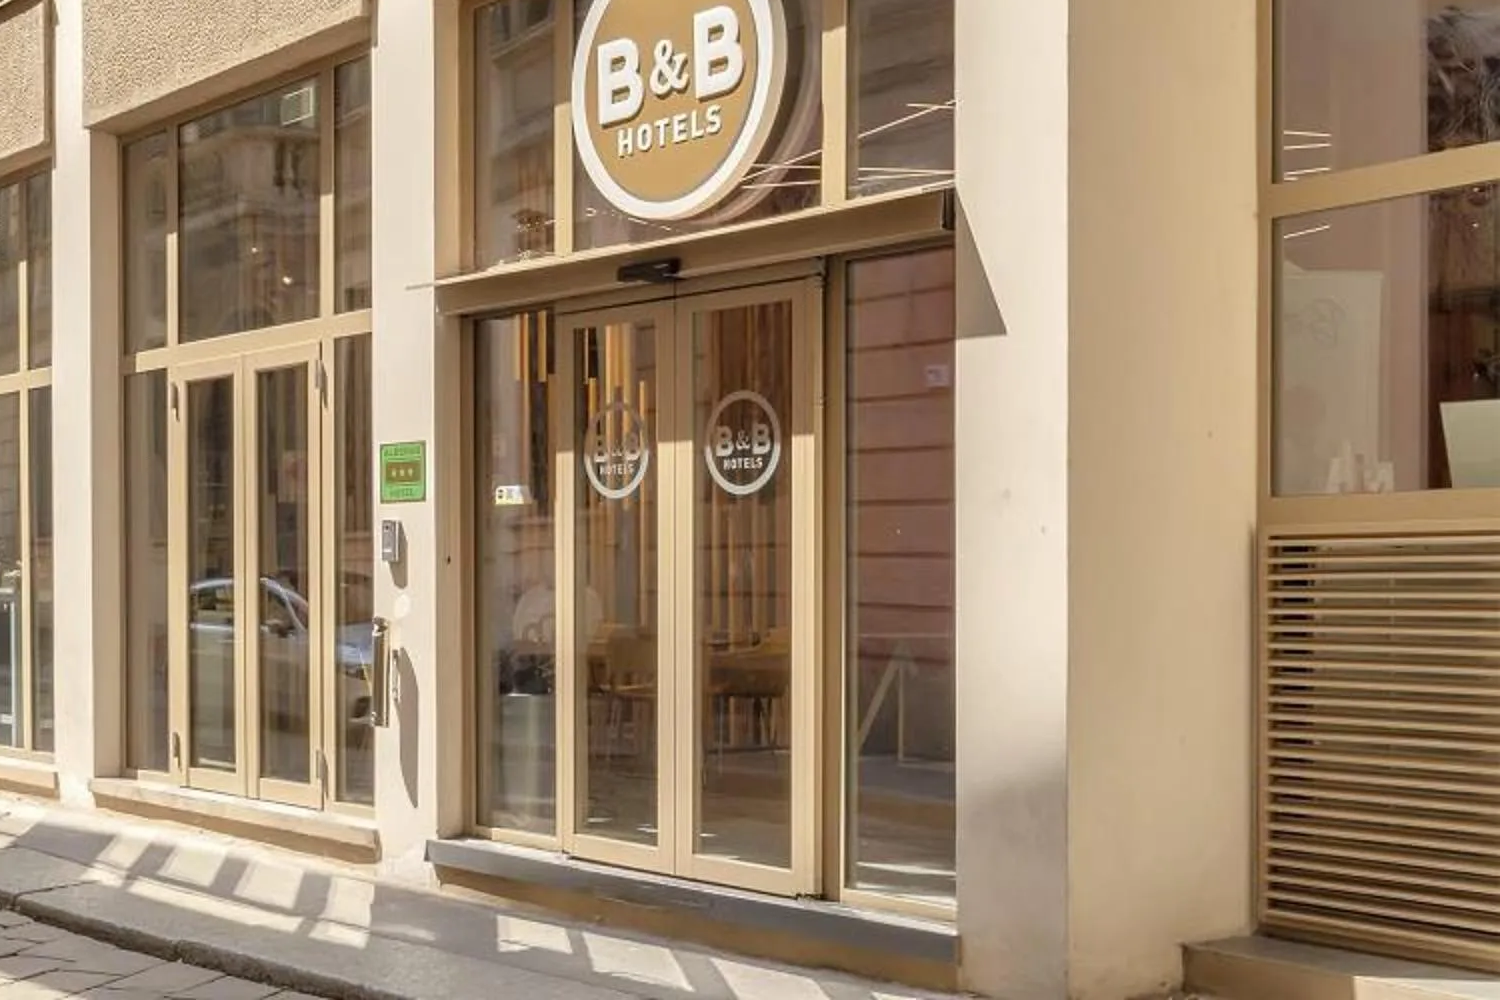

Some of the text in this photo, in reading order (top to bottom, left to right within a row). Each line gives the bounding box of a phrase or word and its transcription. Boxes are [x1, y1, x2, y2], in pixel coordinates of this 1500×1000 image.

[597, 5, 744, 127] B&B
[617, 104, 722, 157] HOTELS
[715, 423, 771, 457] B&B
[723, 457, 763, 471] HOTELS
